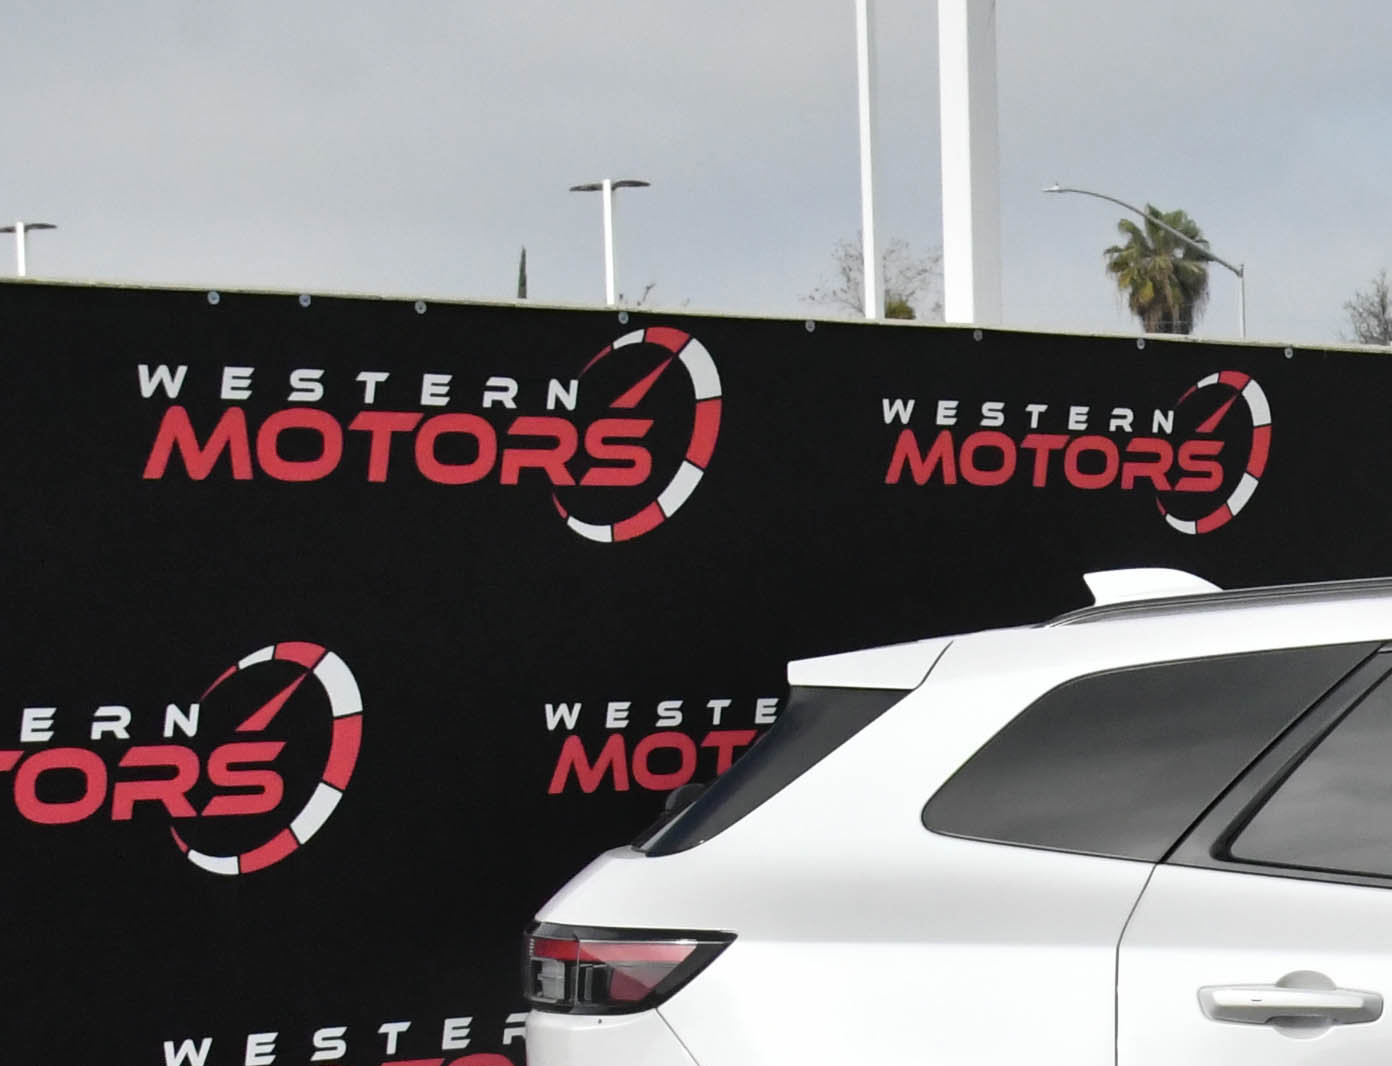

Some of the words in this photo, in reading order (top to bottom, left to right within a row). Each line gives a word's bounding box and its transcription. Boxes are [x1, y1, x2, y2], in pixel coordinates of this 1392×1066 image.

[137, 364, 579, 411] WESTERN
[882, 398, 1174, 434] WESTERN
[143, 404, 654, 487] MOTORS
[885, 428, 1225, 492] MOTORS
[20, 703, 200, 743] ERN
[544, 698, 779, 731] WESTE
[548, 729, 767, 795] MOT
